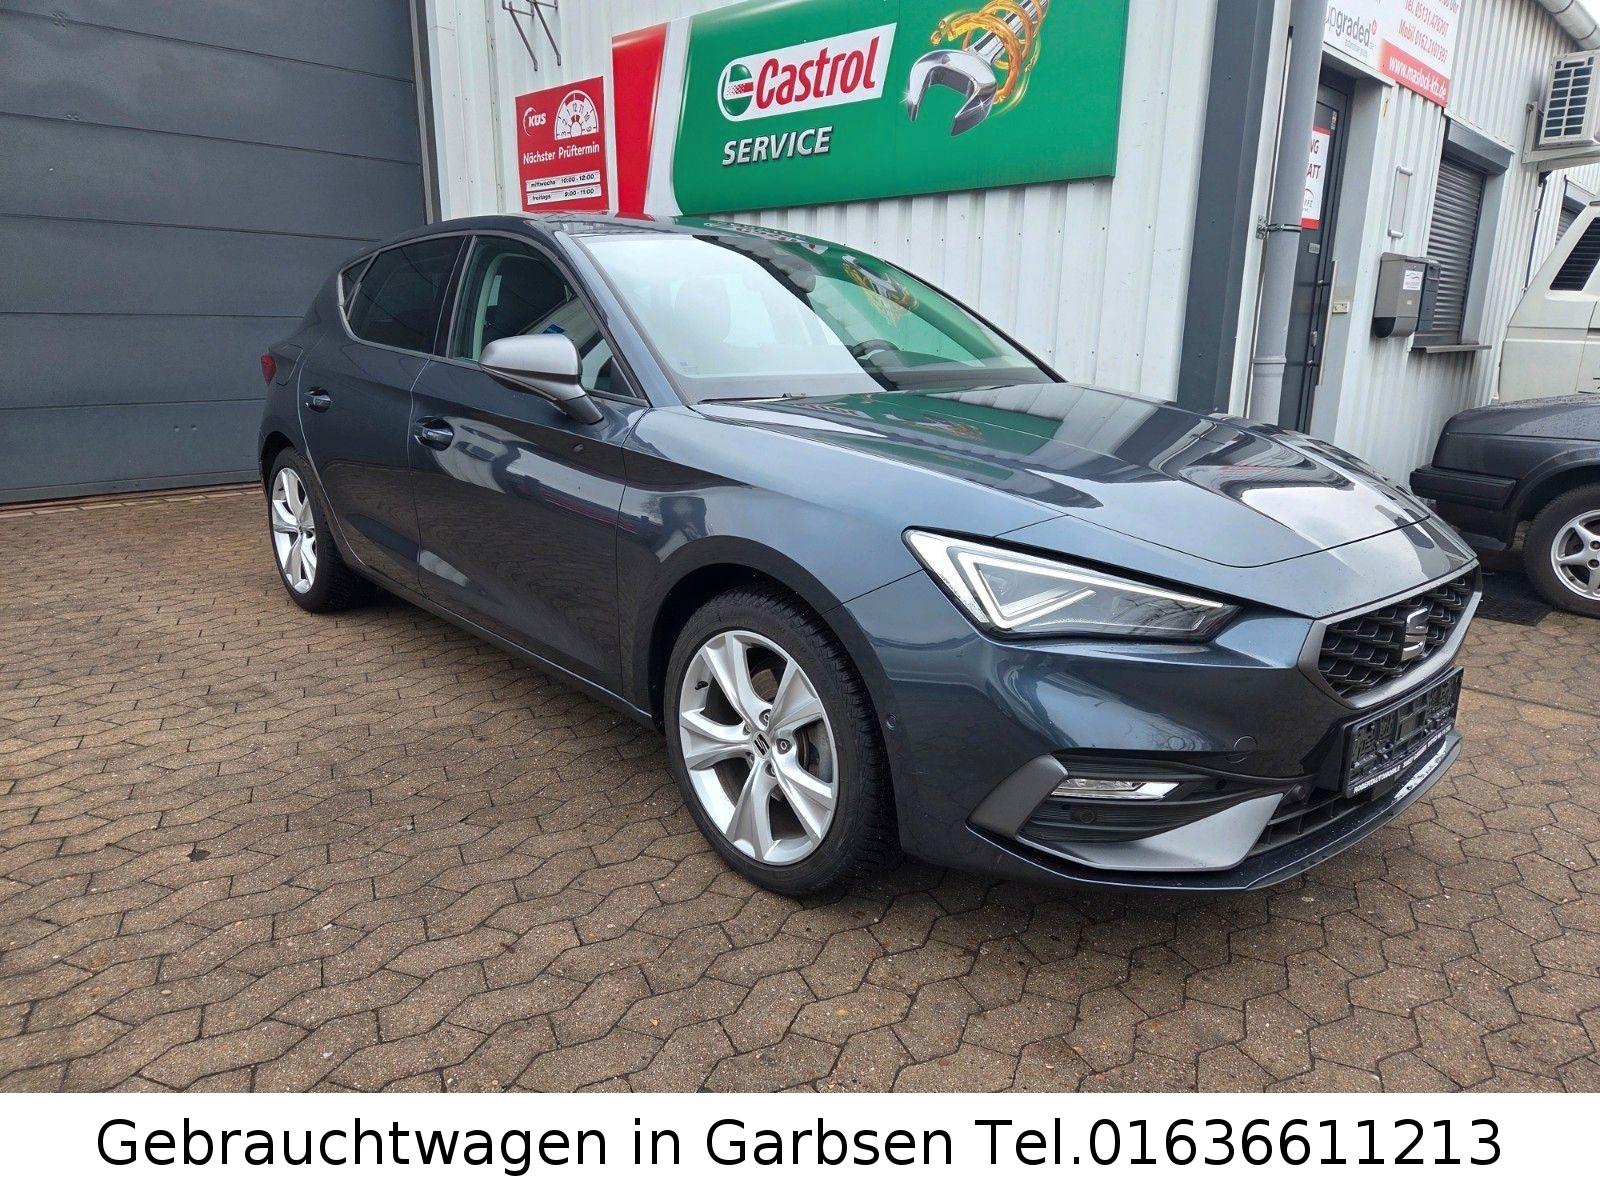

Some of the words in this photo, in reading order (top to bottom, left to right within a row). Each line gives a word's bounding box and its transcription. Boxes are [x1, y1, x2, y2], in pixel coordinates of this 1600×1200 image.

[1399, 19, 1416, 42] Mobil
[756, 36, 880, 109] Castrol
[523, 150, 556, 165] Nächster
[558, 141, 600, 159] Prüftermin
[722, 126, 833, 166] SERVICE
